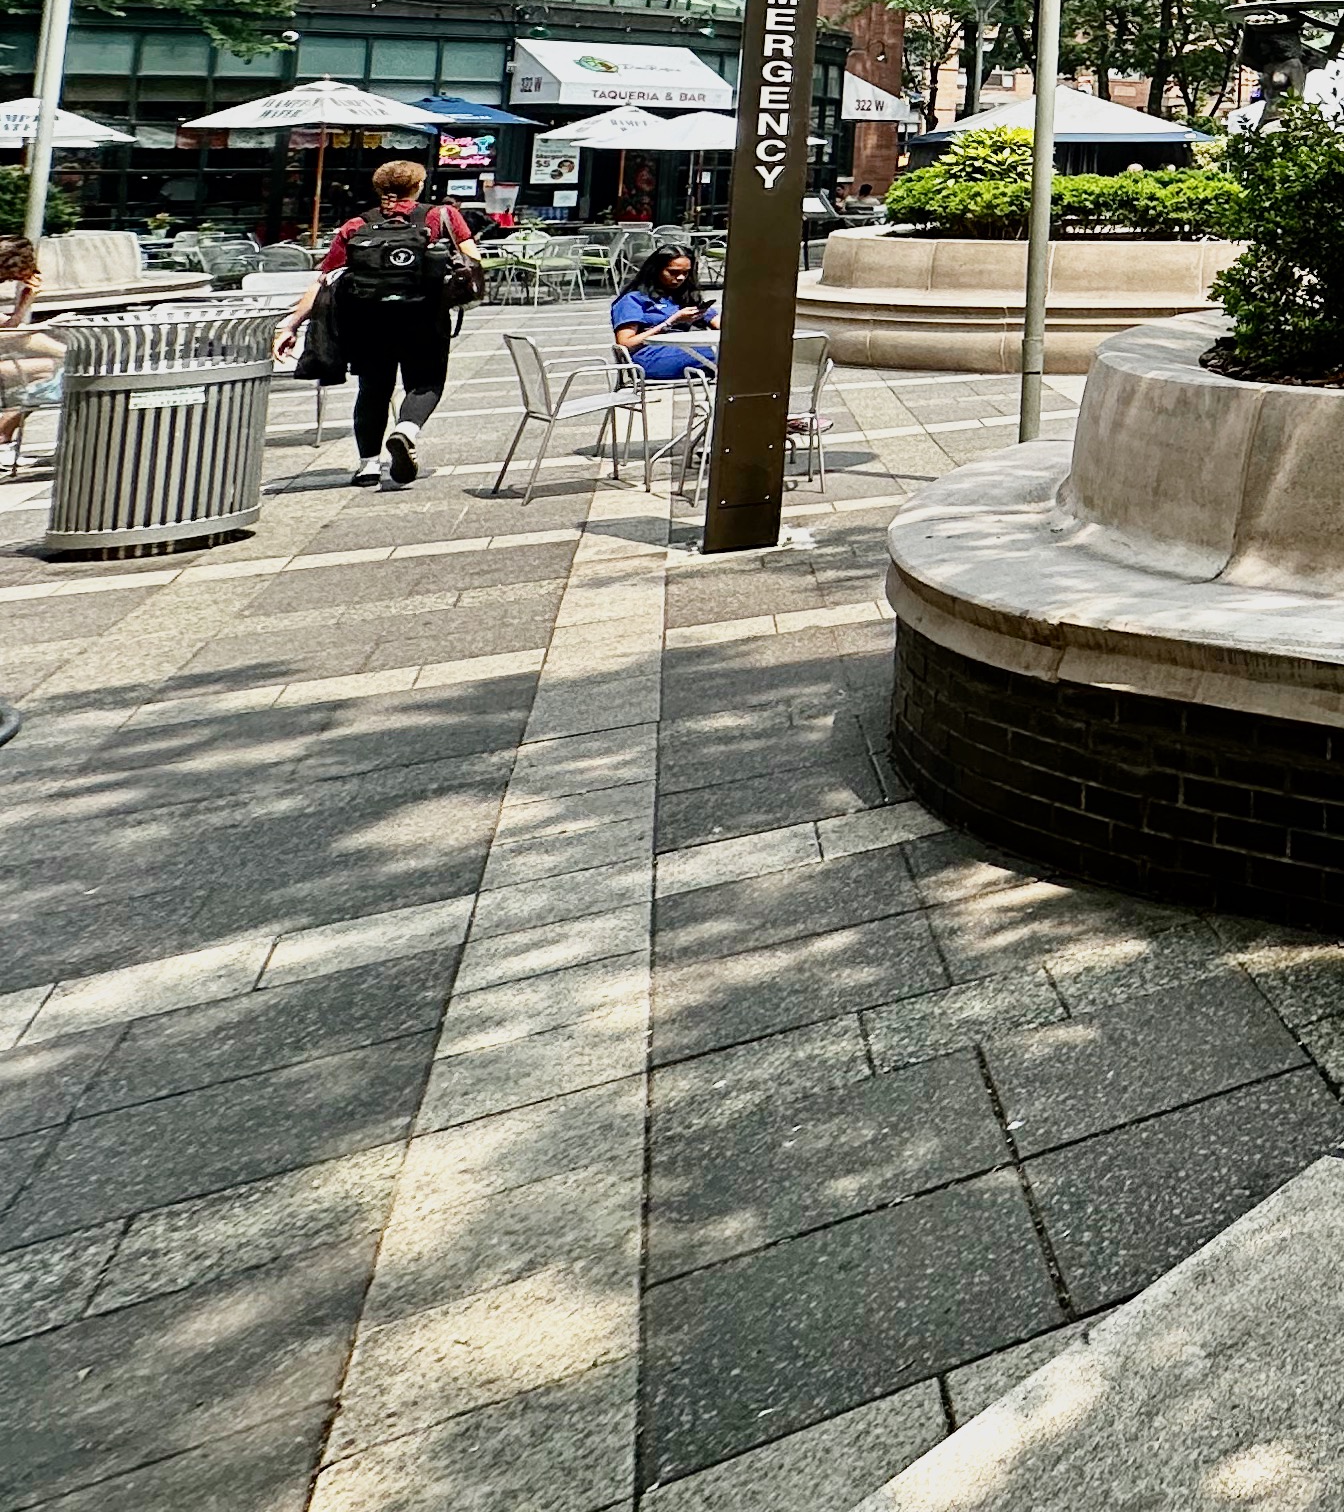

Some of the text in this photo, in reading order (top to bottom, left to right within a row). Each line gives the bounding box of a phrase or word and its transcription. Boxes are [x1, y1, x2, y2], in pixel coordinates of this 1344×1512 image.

[591, 89, 707, 103] TAQUERIA & BAR
[855, 99, 885, 112] 322 W
